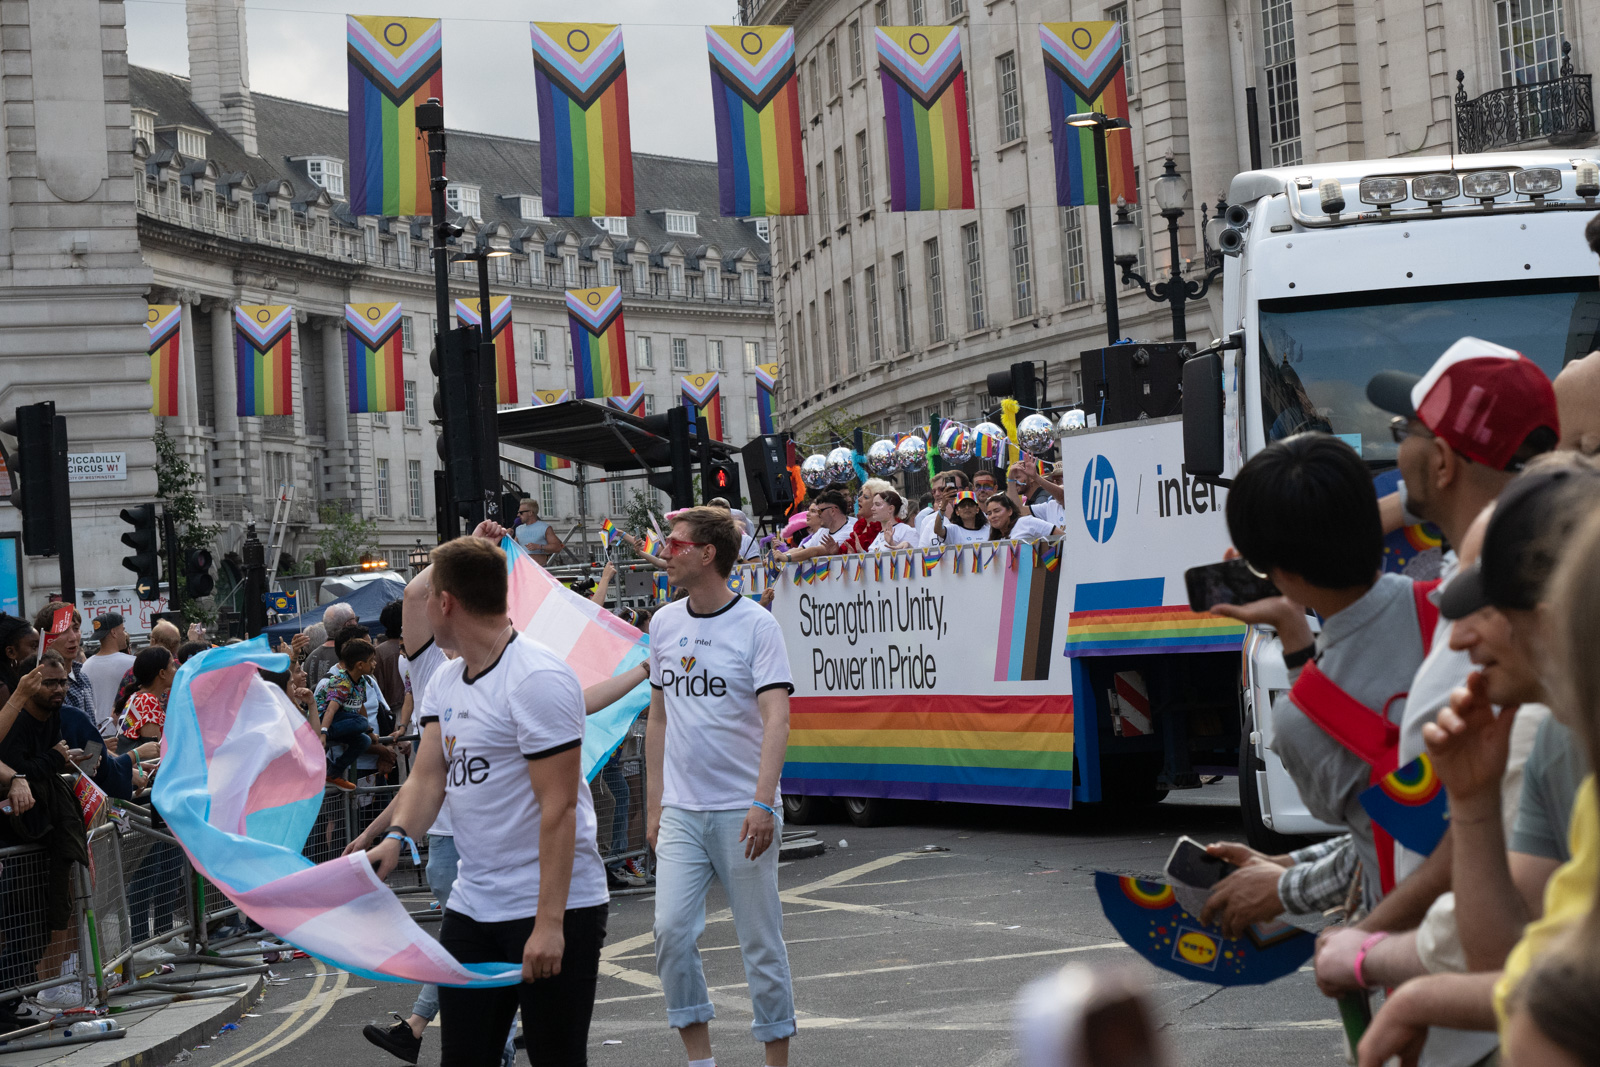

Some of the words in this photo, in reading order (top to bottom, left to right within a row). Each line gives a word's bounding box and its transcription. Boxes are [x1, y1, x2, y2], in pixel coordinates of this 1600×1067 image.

[67, 455, 121, 464] PICCADILLY
[68, 464, 103, 473] CIRCUS
[106, 464, 119, 472] W1
[1084, 454, 1117, 544] hp
[83, 598, 132, 606] PICCADILLY
[799, 589, 876, 646] Strength
[877, 590, 894, 633] in
[896, 586, 947, 641] Unity,
[694, 637, 712, 647] intel
[812, 647, 868, 691] Power
[870, 647, 887, 690] in
[888, 643, 937, 690] Pride
[661, 668, 727, 697] Pride
[447, 748, 490, 788] ide
